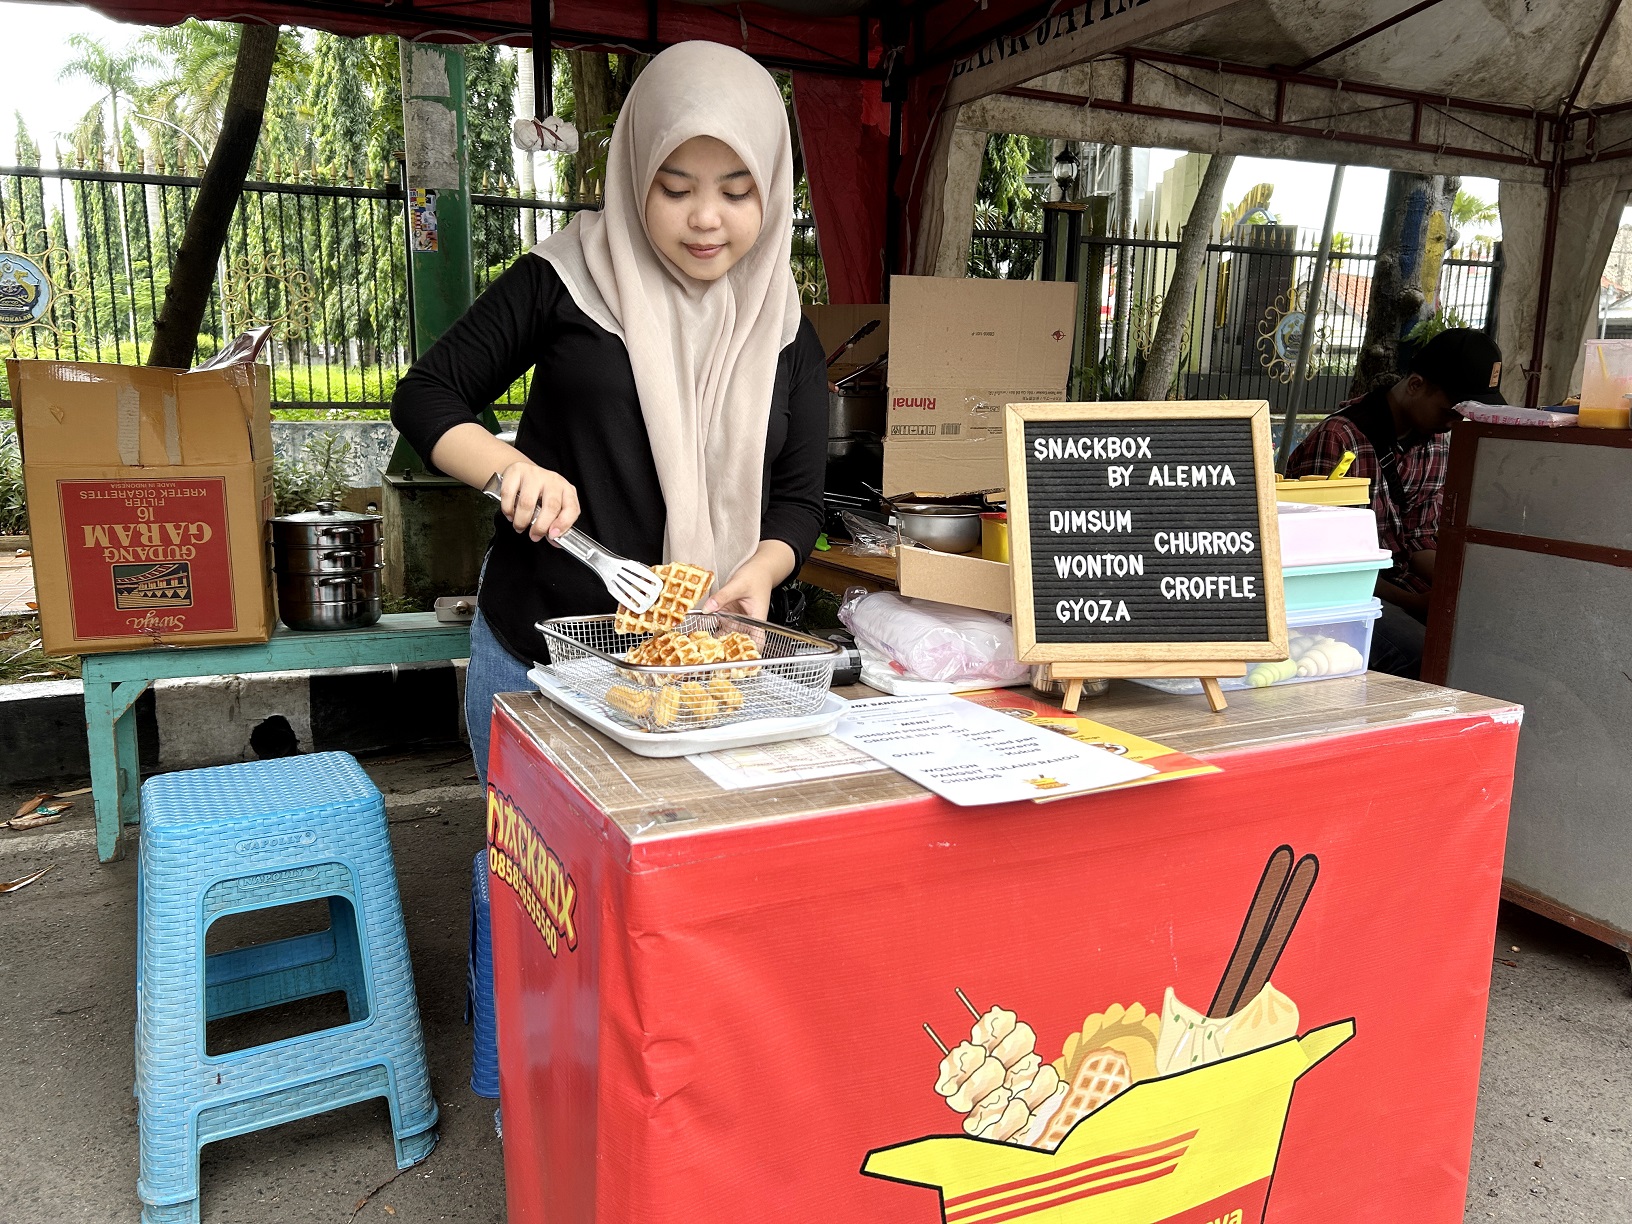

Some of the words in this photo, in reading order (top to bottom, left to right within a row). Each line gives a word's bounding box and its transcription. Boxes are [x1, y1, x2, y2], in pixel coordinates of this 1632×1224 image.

[892, 397, 937, 411] Rinnai
[1033, 436, 1152, 461] SNACKBOX
[1107, 465, 1134, 488] BY
[1148, 465, 1236, 488] ALEMYA
[79, 489, 156, 500] CIGARETTES
[159, 488, 207, 498] KRETEK
[124, 498, 165, 507] FILTER
[136, 506, 155, 522] 16
[1049, 509, 1132, 534] DIMSUM
[80, 521, 213, 548] GARAM
[1154, 531, 1255, 555] CHURROS
[102, 545, 197, 563] GUDANG
[1053, 553, 1144, 579] WONTON
[1160, 575, 1257, 600] CROFFLE
[1055, 598, 1131, 624] GYOZA
[125, 609, 186, 632] Surya
[854, 730, 900, 739] DIMSUM
[902, 724, 953, 733] PREMIUM
[901, 719, 930, 727] MENU
[919, 763, 979, 774] WONTON
[929, 769, 983, 780] PANGSIT
[987, 762, 1037, 772] TULANG
[941, 773, 1002, 784] CHURROS
[487, 790, 575, 941] NACKBOX
